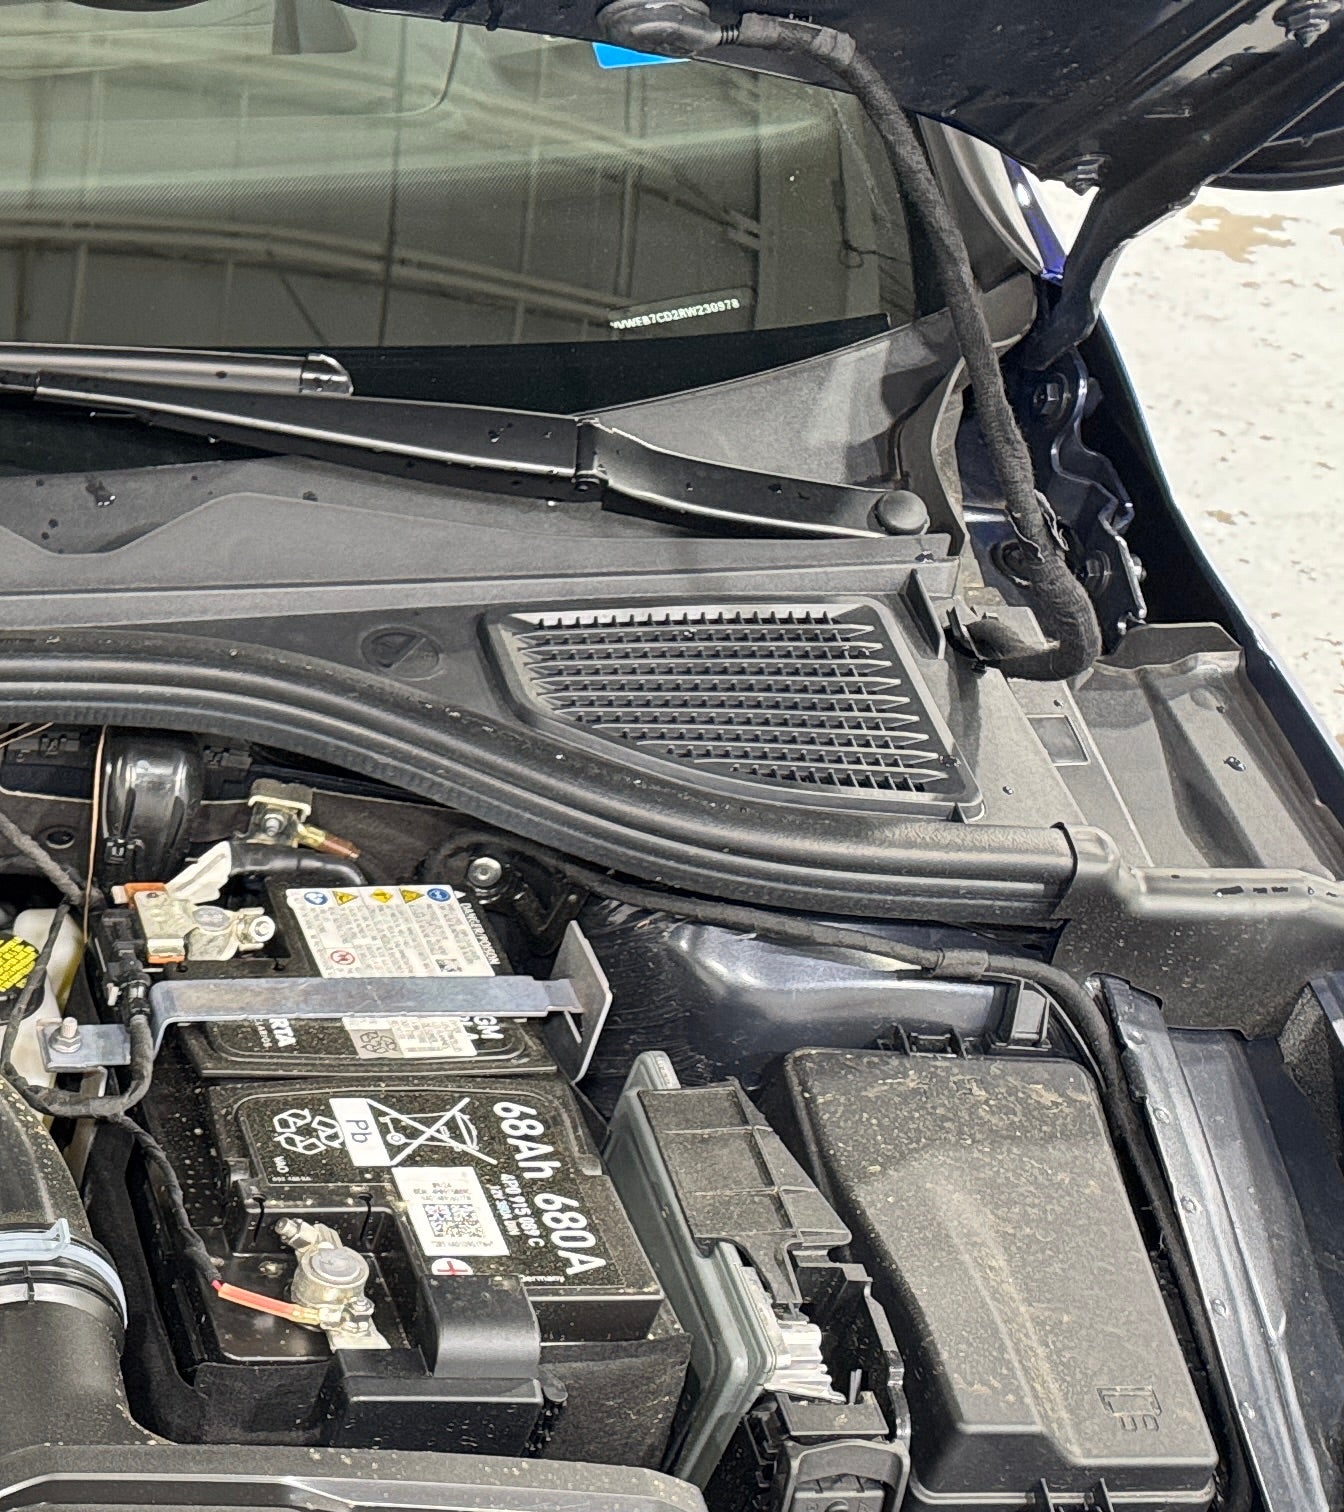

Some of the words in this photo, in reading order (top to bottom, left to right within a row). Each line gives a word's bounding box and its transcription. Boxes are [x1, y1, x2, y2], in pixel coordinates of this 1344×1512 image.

[269, 1018, 297, 1047] RTA
[473, 1015, 504, 1039] GM
[345, 1118, 369, 1144] Pb
[493, 1101, 562, 1179] 68Ah
[534, 1193, 607, 1275] 680A
